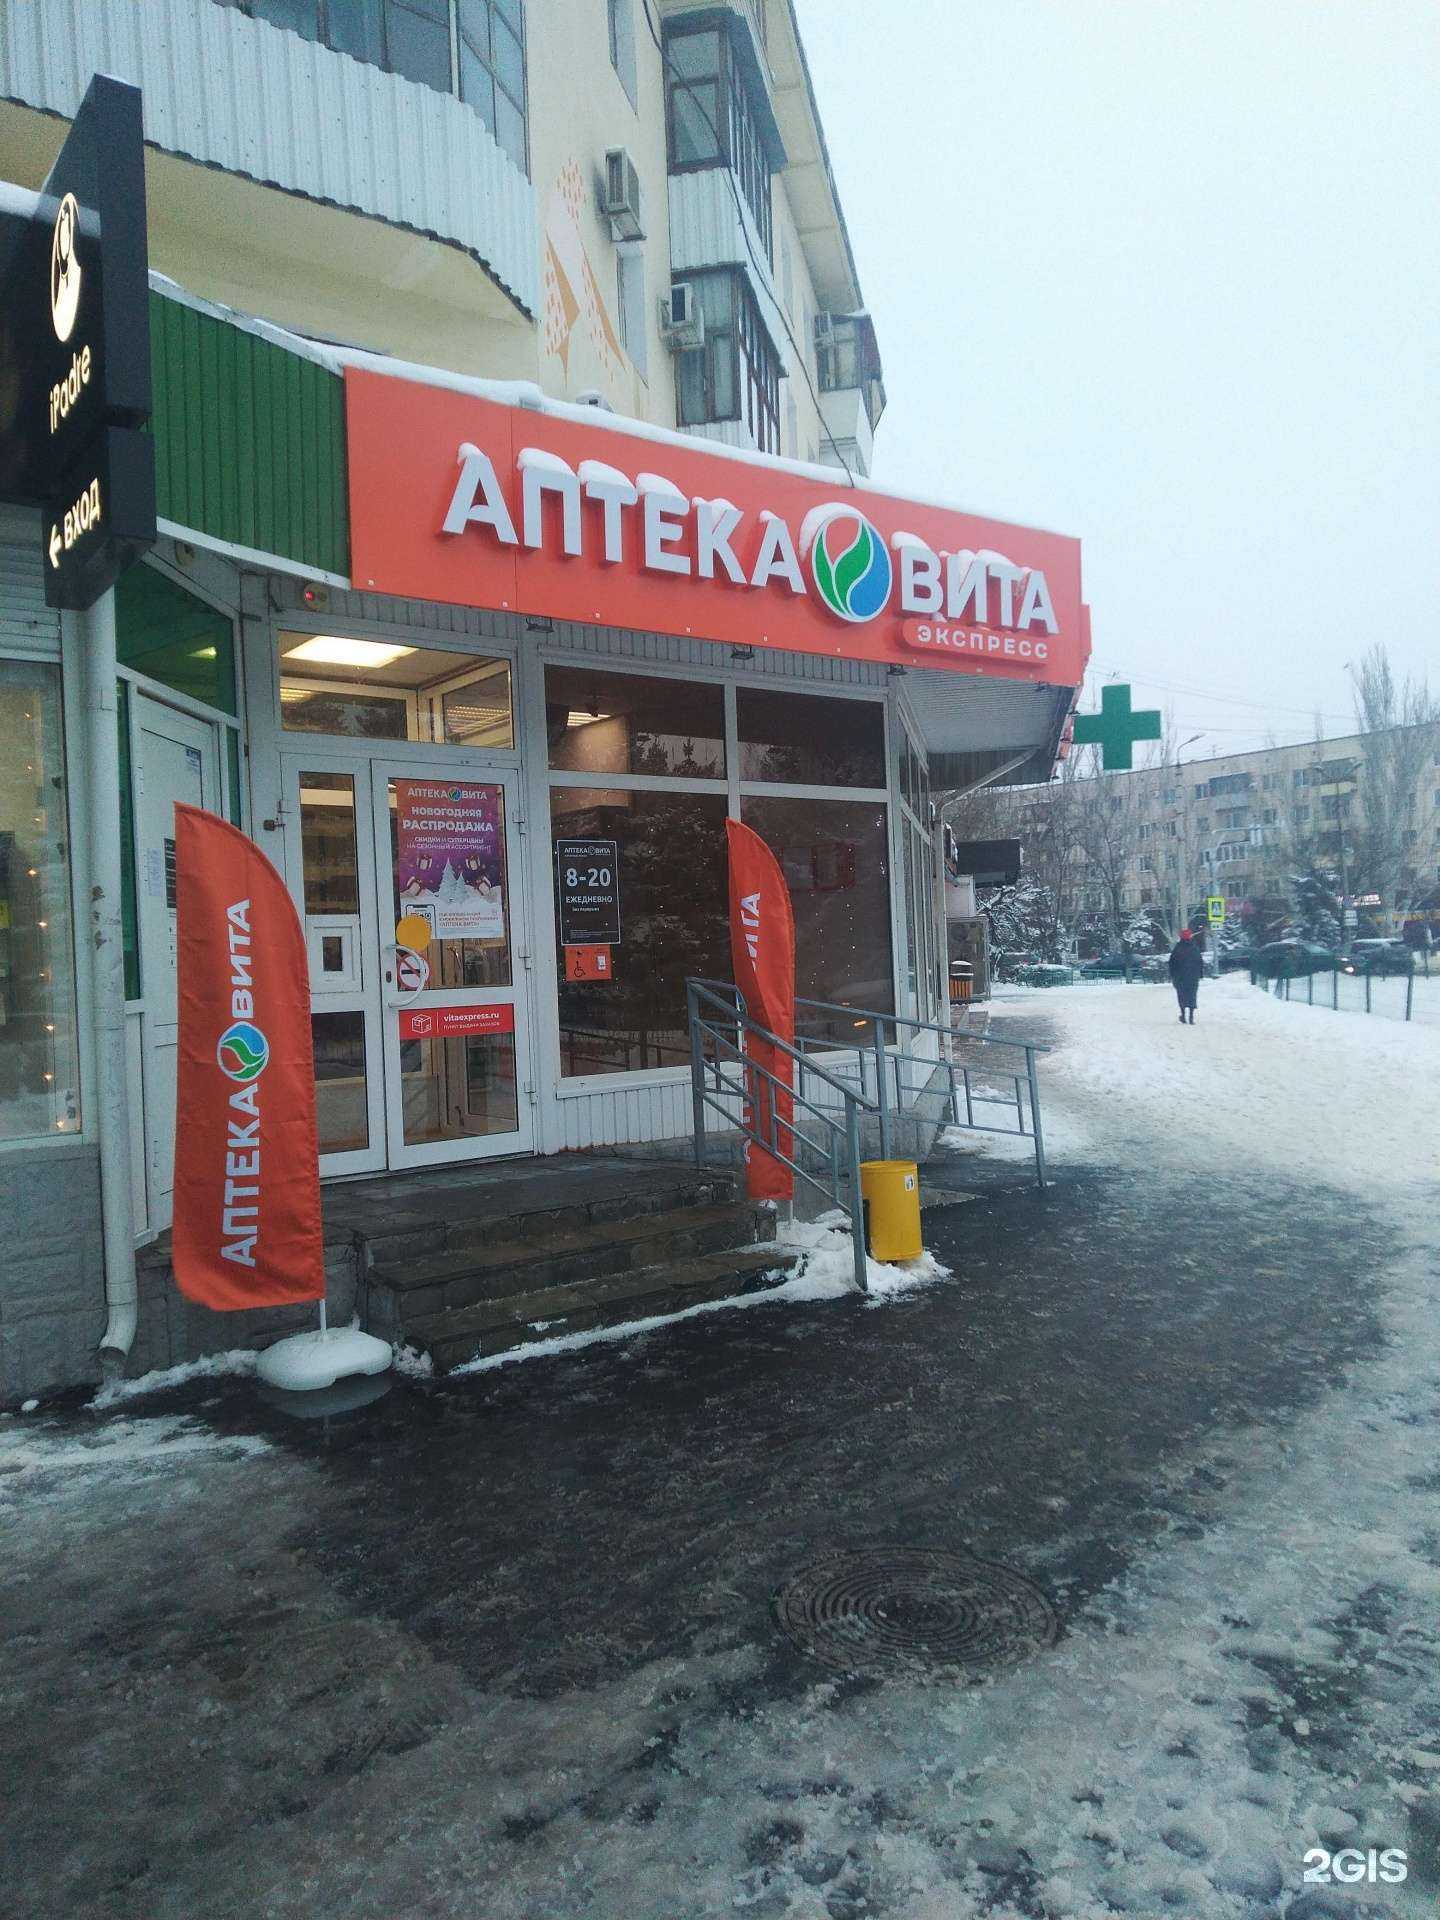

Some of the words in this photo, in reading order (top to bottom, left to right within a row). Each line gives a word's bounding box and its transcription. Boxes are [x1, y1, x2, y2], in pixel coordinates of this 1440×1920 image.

[50, 345, 91, 434] iPadre
[63, 478, 101, 550] ВХОД
[442, 448, 808, 596] АПТЕКА
[901, 541, 1060, 634] ВИТА
[916, 627, 1050, 660] ЭКСПРЕСС
[408, 787, 448, 799] АПТЕКА
[461, 790, 488, 800] ВИТА
[411, 806, 482, 818] НОВОГОДНЯЯ
[402, 819, 494, 832] РАСПРОДАЖА
[566, 867, 612, 887] 8-20
[565, 895, 613, 904] ЕЖЕДНЕВНО
[226, 899, 255, 1019] ВИТА
[443, 1012, 500, 1022] vitaexpress.ru
[220, 1083, 261, 1268] АПТЕКА
